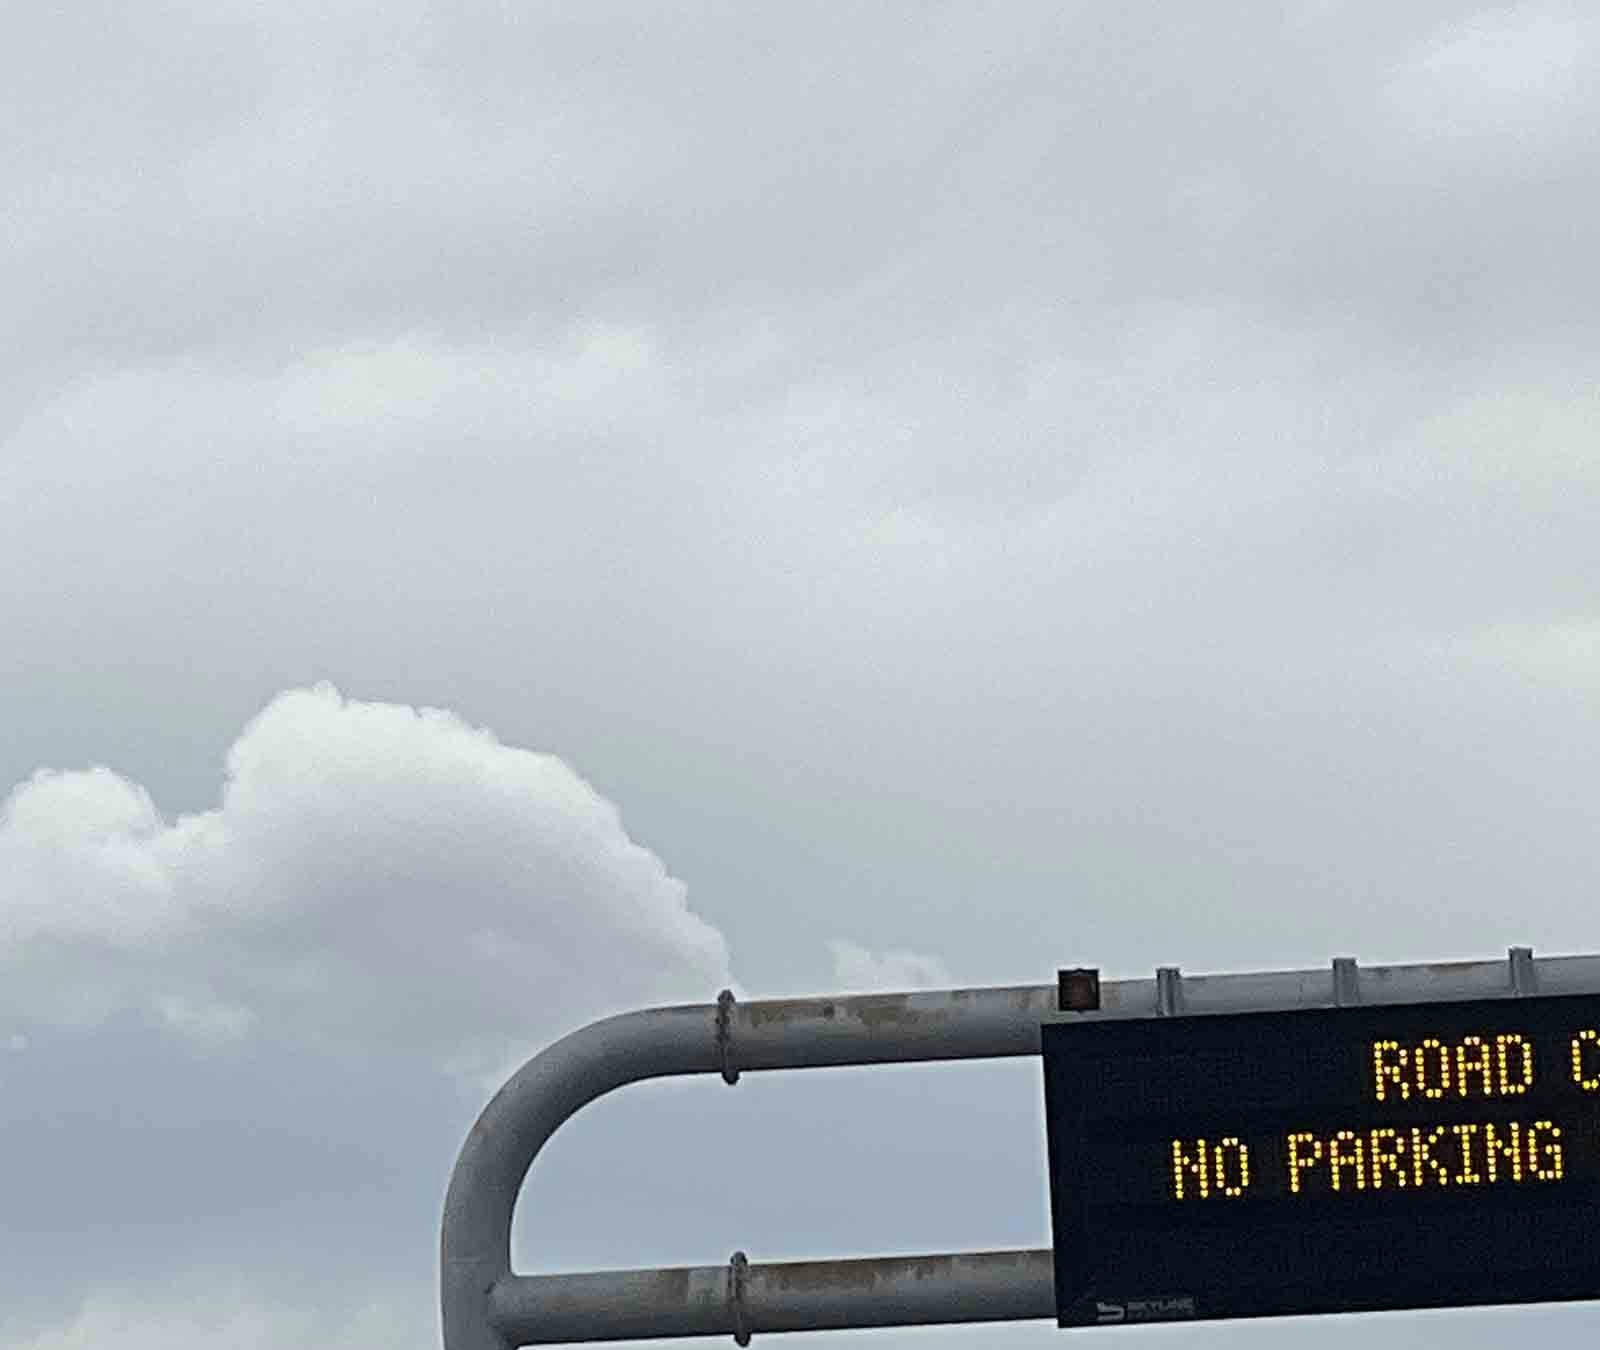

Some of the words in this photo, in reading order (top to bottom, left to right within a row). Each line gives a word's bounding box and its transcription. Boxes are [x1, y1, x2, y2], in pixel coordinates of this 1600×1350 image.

[1373, 1033, 1533, 1101] ROAD
[1171, 1137, 1249, 1200] NO
[1286, 1120, 1564, 1194] PARKING
